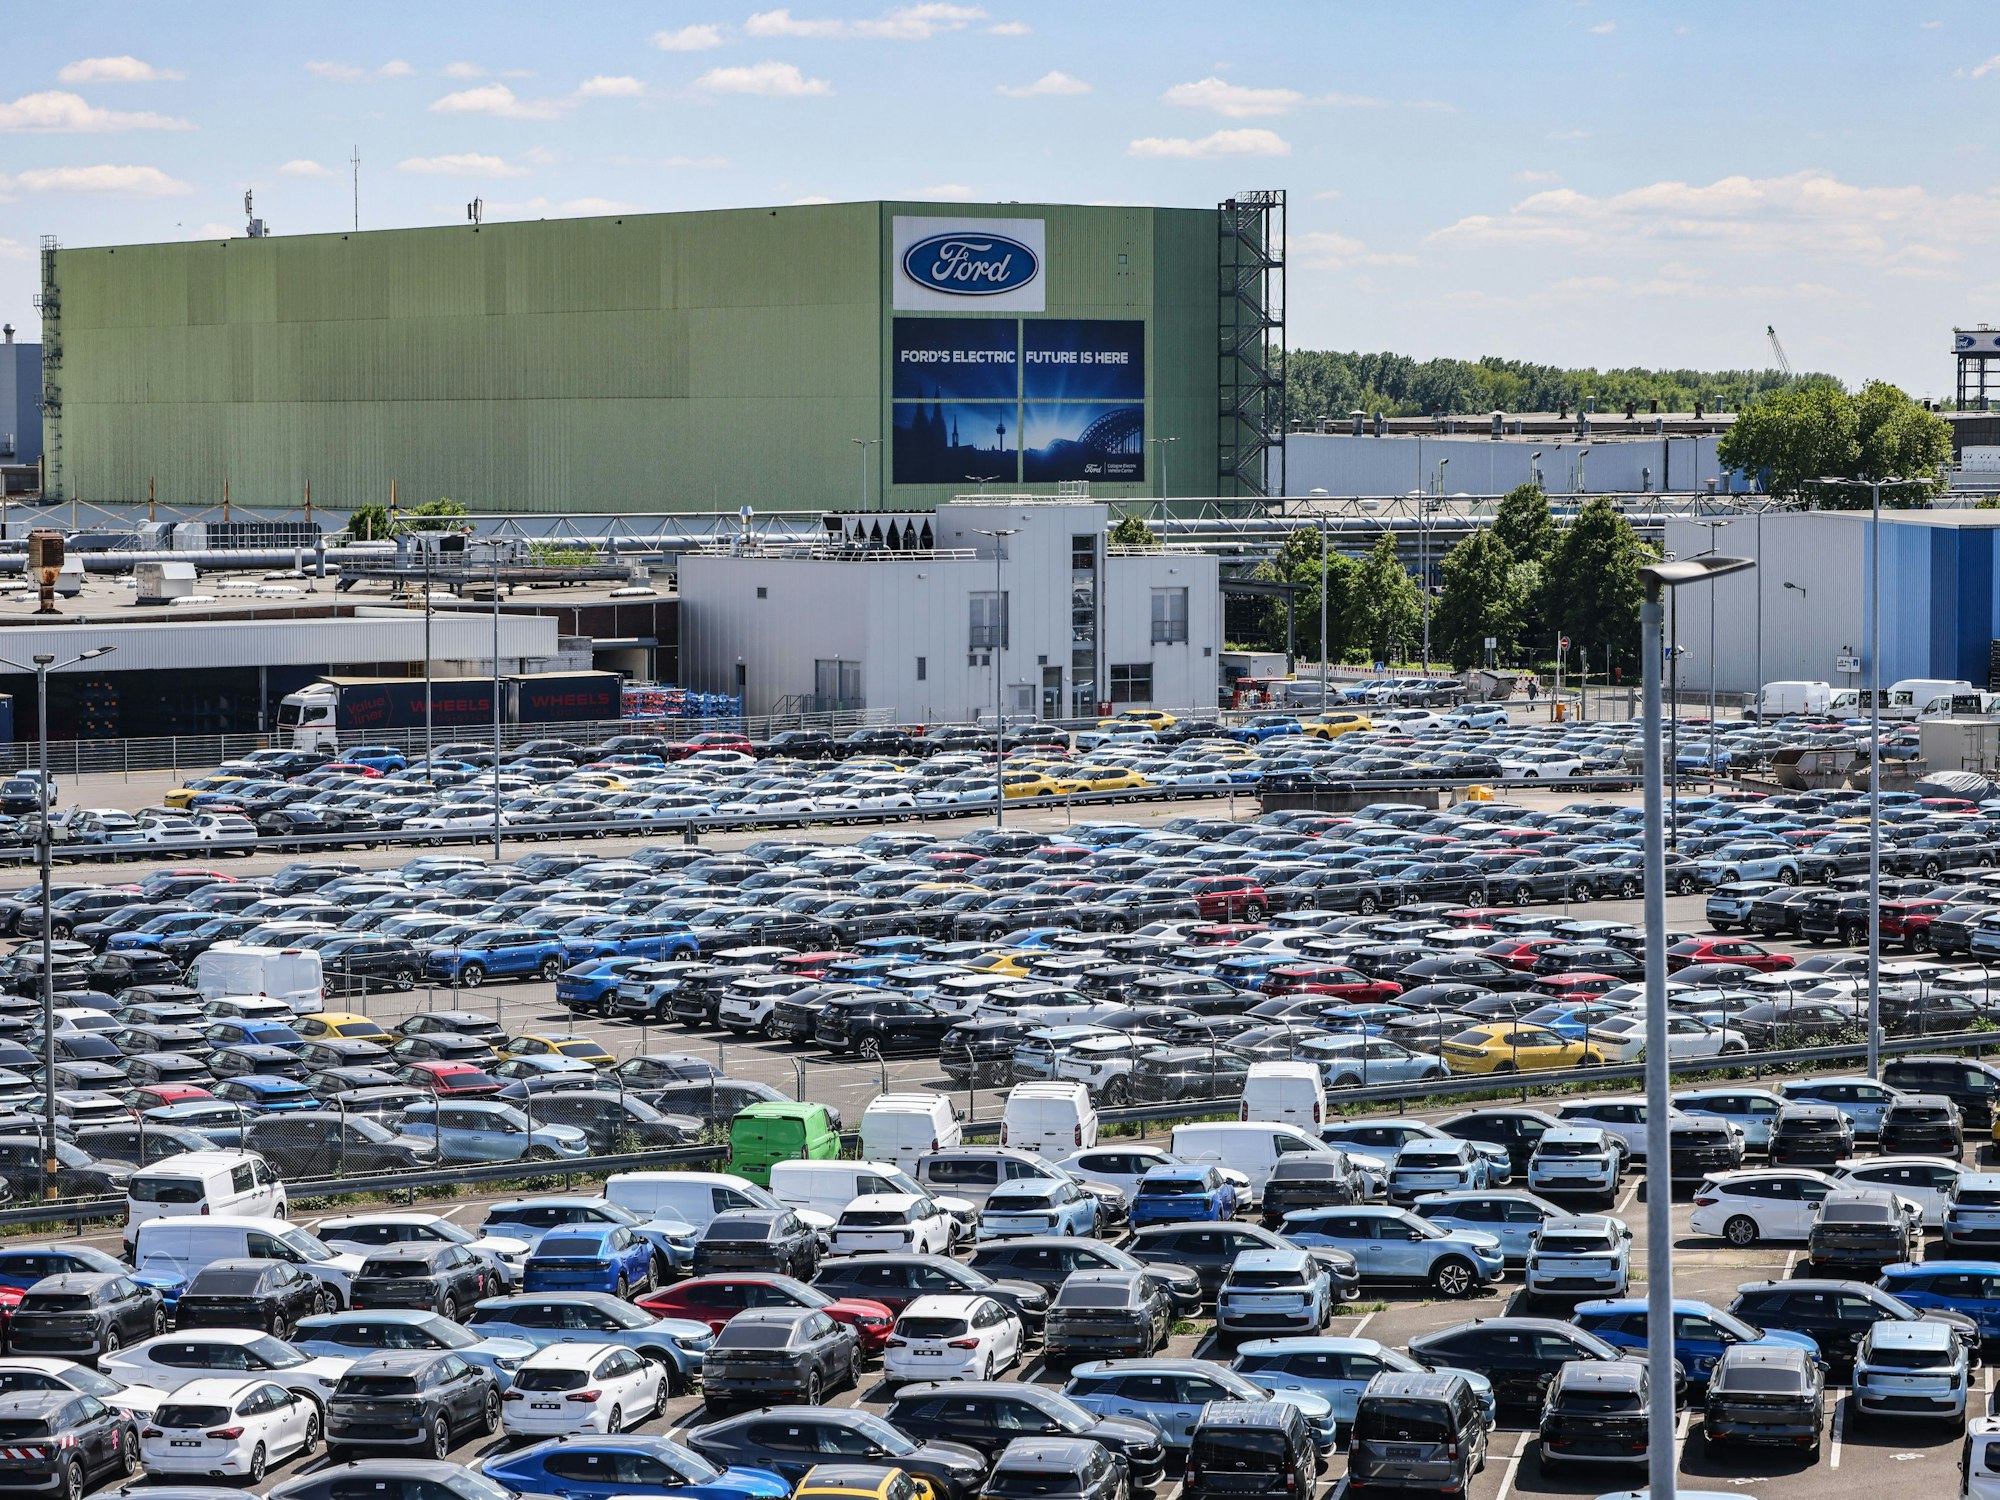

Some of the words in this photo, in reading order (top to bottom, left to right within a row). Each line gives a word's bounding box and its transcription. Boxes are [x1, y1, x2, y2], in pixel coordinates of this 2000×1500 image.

[931, 241, 1012, 282] Ford
[901, 350, 950, 363] FORD'S
[952, 350, 1016, 363] ELECTRIC
[1025, 351, 1078, 364] FUTURE
[1080, 351, 1093, 364] IS
[1095, 352, 1129, 364] HERE
[1084, 463, 1102, 473] Ford
[346, 697, 385, 715] Value
[410, 699, 490, 713] WHEELS
[532, 693, 610, 708] WHEELS
